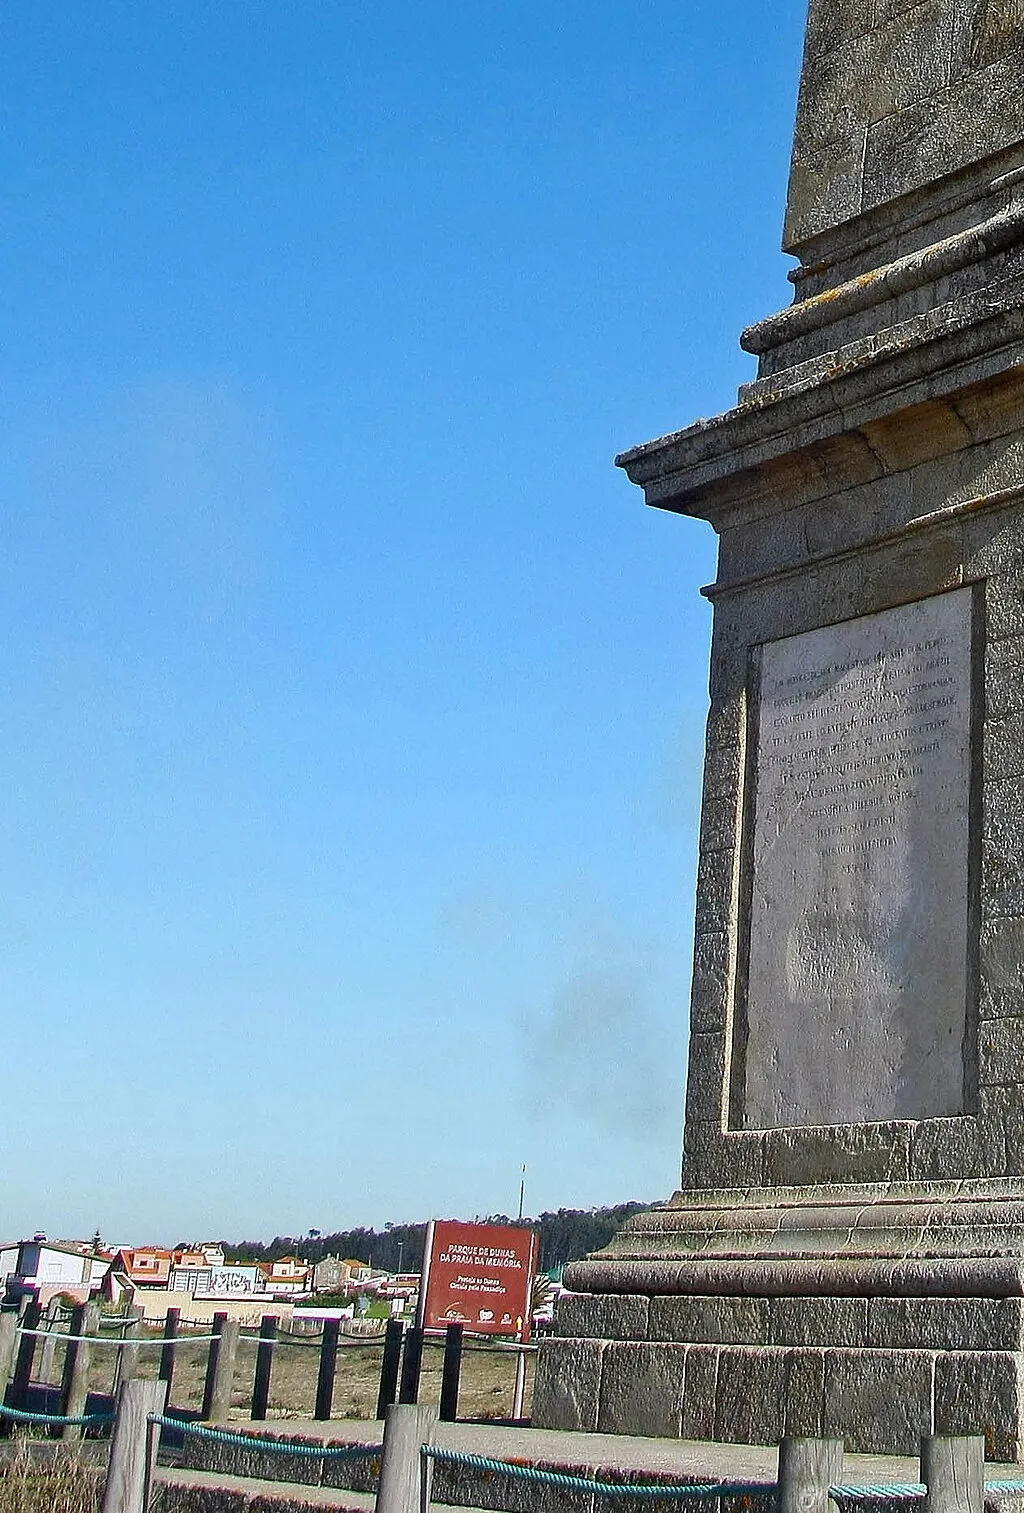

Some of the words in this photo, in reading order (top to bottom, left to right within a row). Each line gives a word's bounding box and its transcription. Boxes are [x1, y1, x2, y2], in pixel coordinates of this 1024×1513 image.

[448, 1244, 478, 1255] PARQUE
[478, 1247, 489, 1256] DE
[490, 1248, 516, 1258] DUNAS
[440, 1254, 451, 1263] DA
[451, 1254, 474, 1265] PRAIA
[474, 1257, 485, 1266] DA
[486, 1257, 522, 1269] MEMÓRIA
